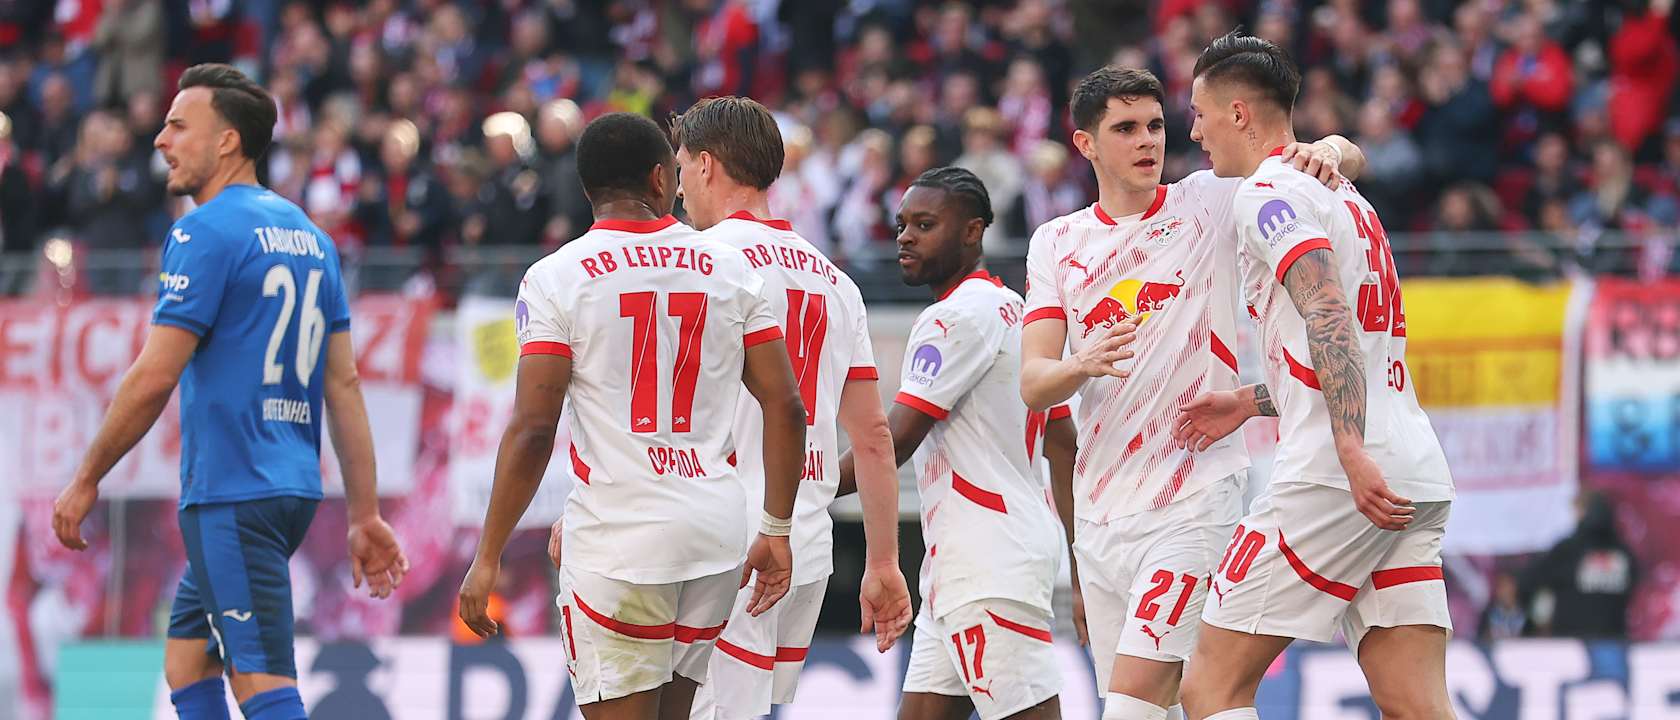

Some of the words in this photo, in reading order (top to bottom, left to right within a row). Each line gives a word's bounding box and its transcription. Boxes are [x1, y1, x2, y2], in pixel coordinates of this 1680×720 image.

[581, 251, 618, 278] RB
[622, 246, 713, 276] LEIPZIG
[1268, 219, 1302, 249] kraken
[742, 244, 772, 269] RB
[771, 244, 838, 286] LEIPZIG
[262, 264, 325, 389] 26
[619, 291, 708, 433] 11
[1217, 524, 1266, 583] 30
[1134, 569, 1198, 627] 21
[951, 623, 986, 684] 17
